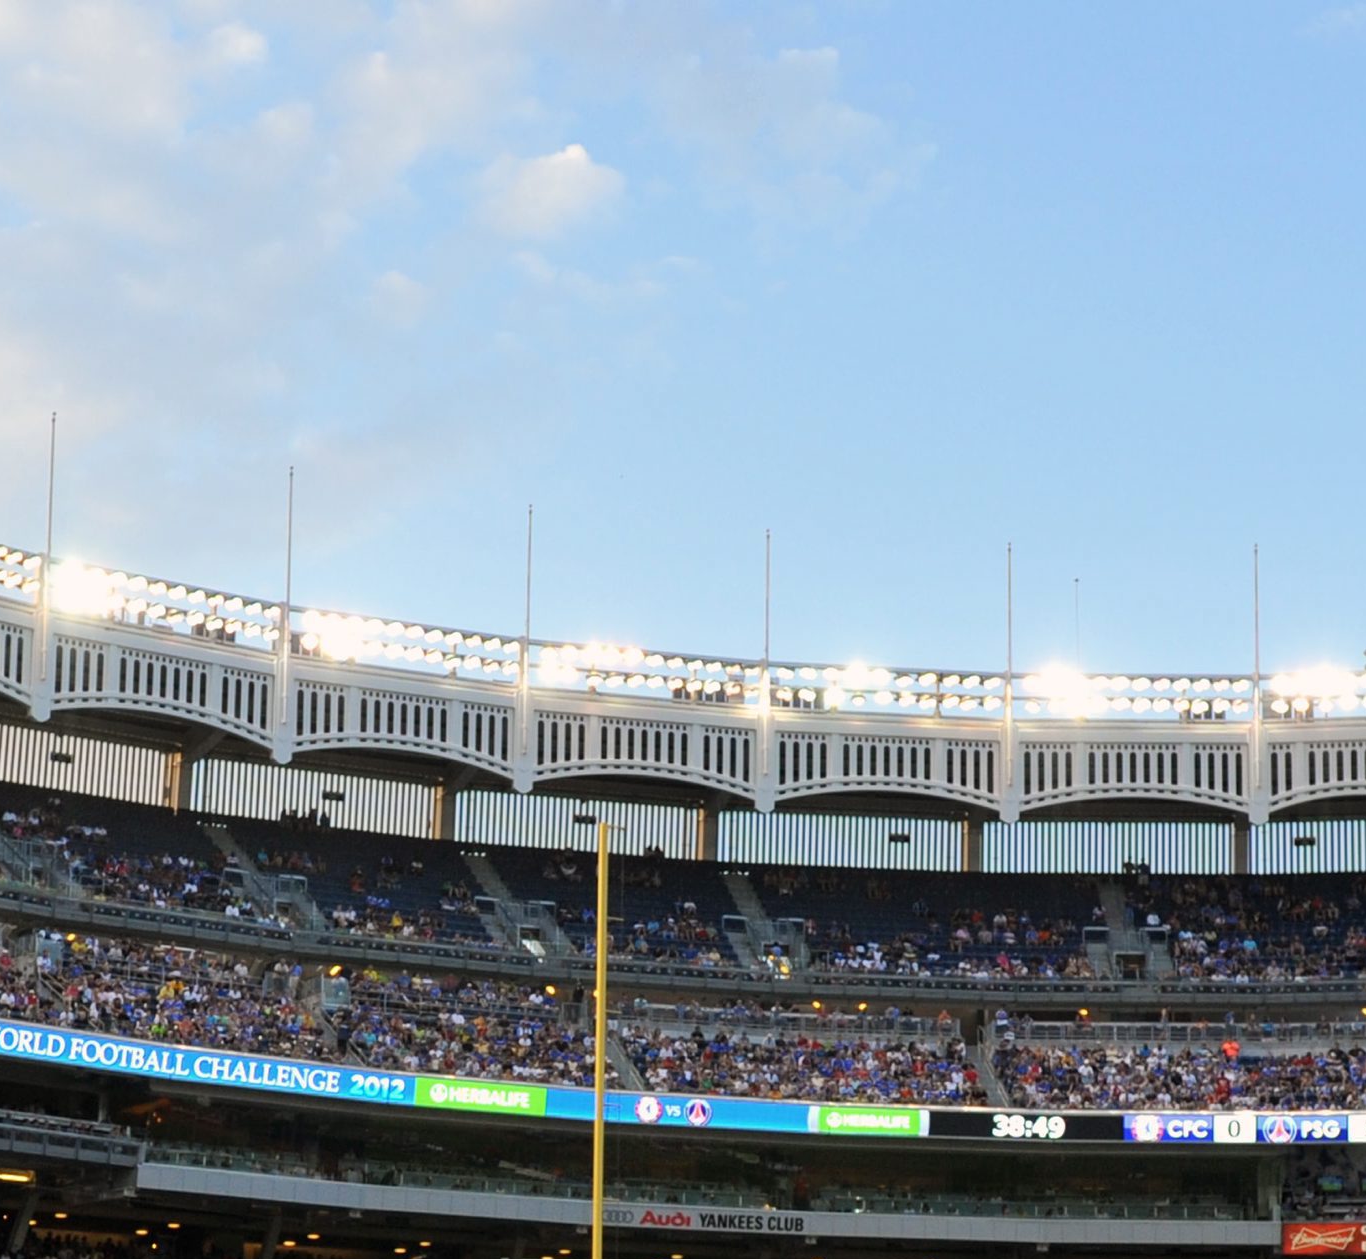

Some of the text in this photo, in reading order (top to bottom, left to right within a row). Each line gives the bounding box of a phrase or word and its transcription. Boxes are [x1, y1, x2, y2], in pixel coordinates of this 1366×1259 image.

[68, 1037, 190, 1077] FOOTBALL
[193, 1055, 341, 1093] CHALLENGE
[349, 1074, 405, 1099] 2012
[448, 1086, 531, 1109] HERBALIFE
[842, 1112, 910, 1130] HERBALIFE
[991, 1114, 1066, 1138] 38:49
[1166, 1119, 1209, 1139] CFC
[1228, 1119, 1241, 1138] 0
[1300, 1119, 1341, 1139] PSG
[639, 1210, 805, 1233] Audi YANKEES CLUB
